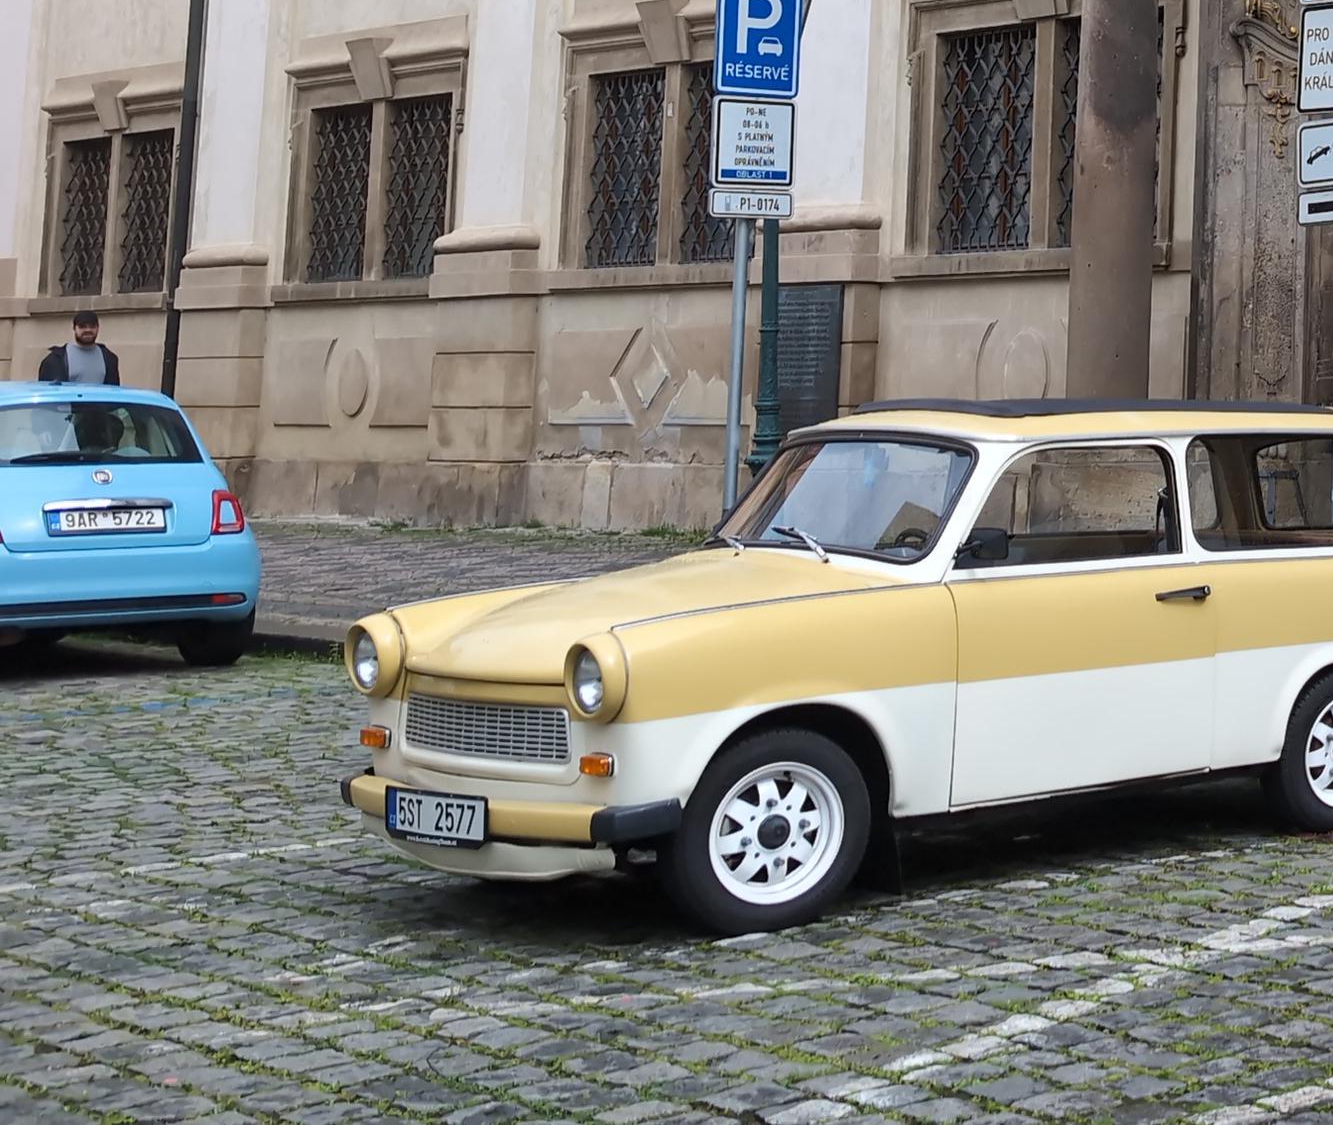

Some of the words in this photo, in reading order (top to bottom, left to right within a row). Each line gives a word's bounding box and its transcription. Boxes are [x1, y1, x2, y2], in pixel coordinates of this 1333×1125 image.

[1306, 27, 1330, 43] PRO
[725, 60, 790, 81] RÉSERVÉ
[746, 107, 767, 117] PO-NE
[737, 132, 742, 141] S
[744, 131, 774, 142] PLATNÝM
[735, 144, 775, 155] PARKOVACÍM
[734, 155, 775, 167] OPRÁVNĚNÍM
[736, 170, 764, 179] OBLAST
[769, 171, 773, 179] 1
[740, 197, 780, 212] P1-0174
[65, 512, 98, 528] 9AR
[112, 510, 156, 526] 5722
[399, 796, 423, 830] 5ST
[434, 801, 476, 835] 2577
